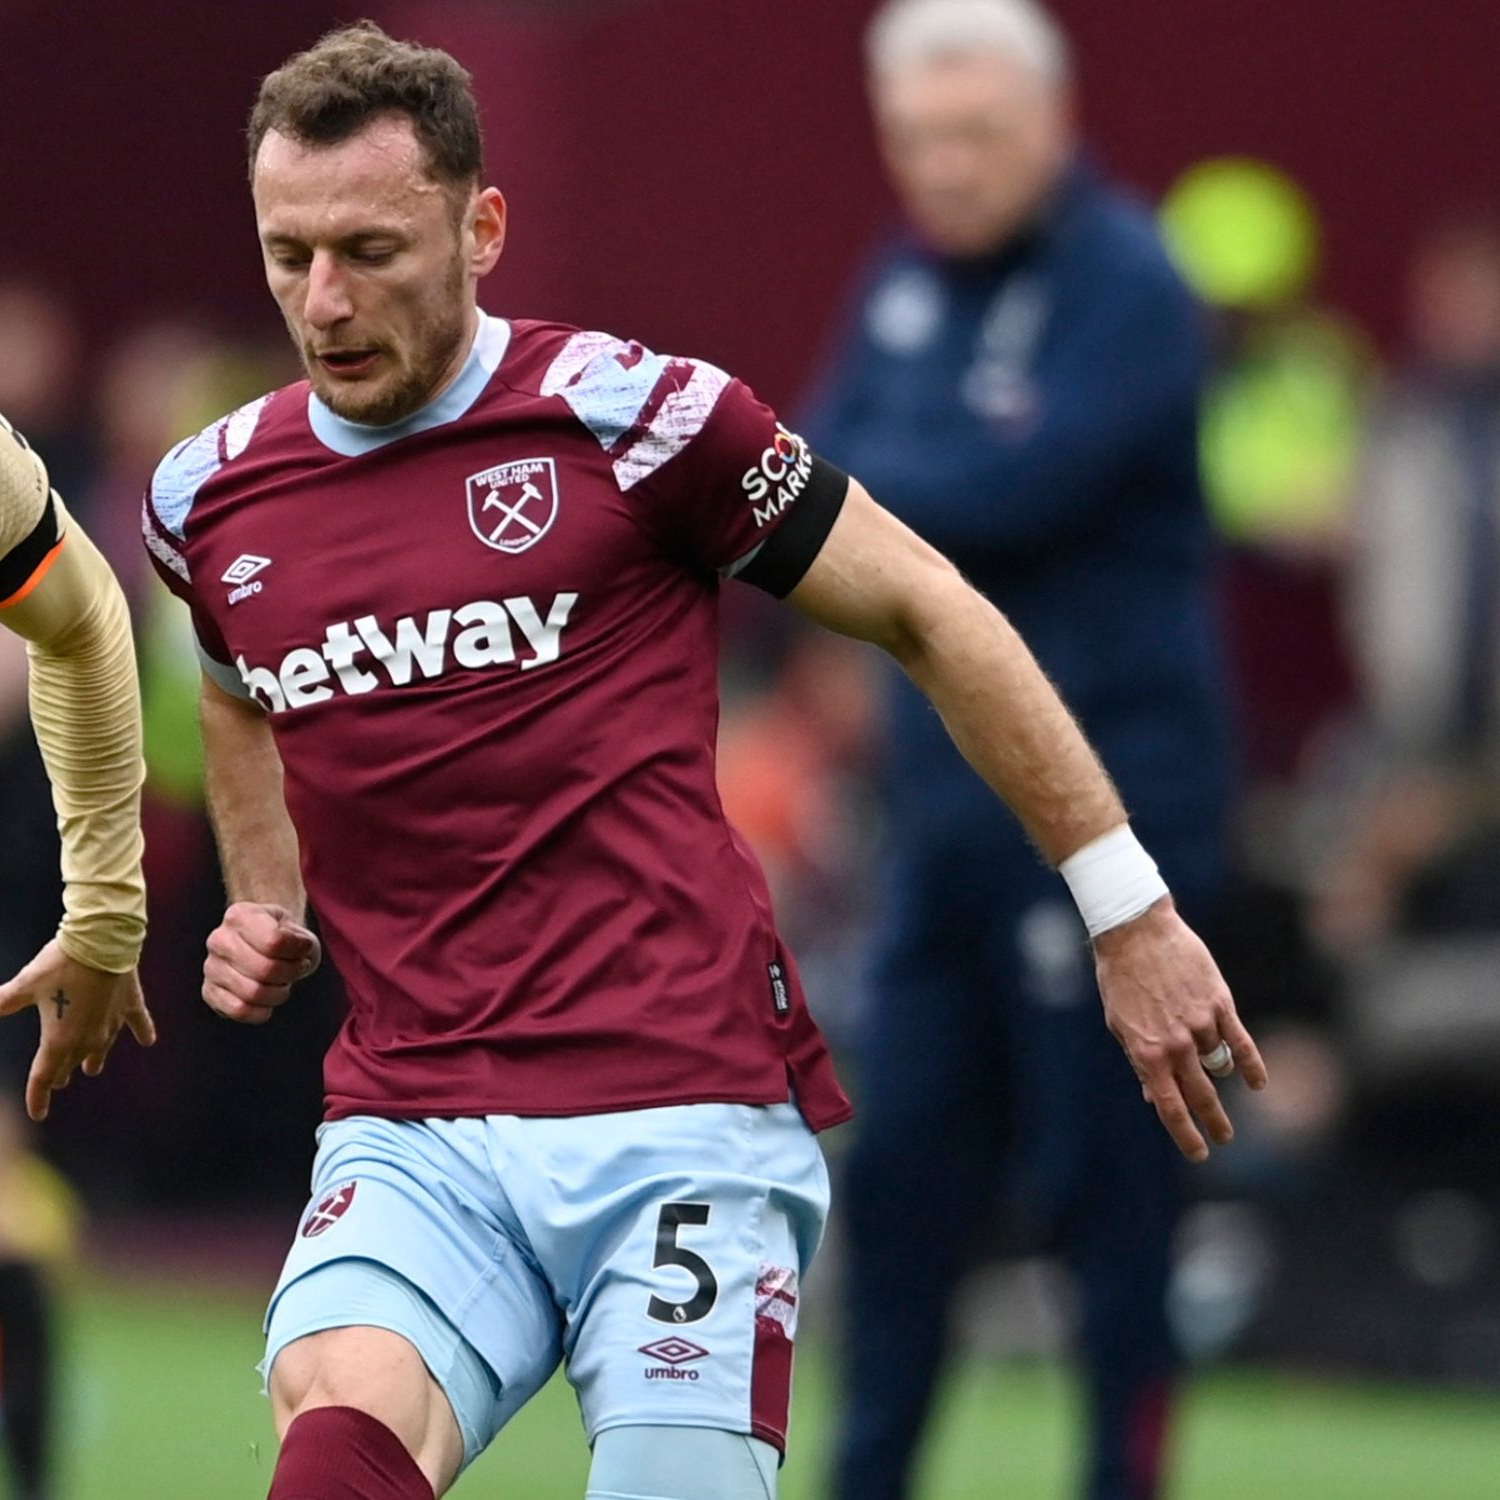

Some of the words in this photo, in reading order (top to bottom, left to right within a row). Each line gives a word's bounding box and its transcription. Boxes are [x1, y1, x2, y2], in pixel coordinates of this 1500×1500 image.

[742, 421, 808, 500] SCO
[475, 468, 509, 487] WEST
[511, 463, 544, 475] HAM
[490, 473, 530, 489] UNITED
[228, 581, 262, 605] umbro
[236, 593, 579, 713] betway
[645, 1202, 718, 1324] 5
[644, 1366, 699, 1380] umbro
